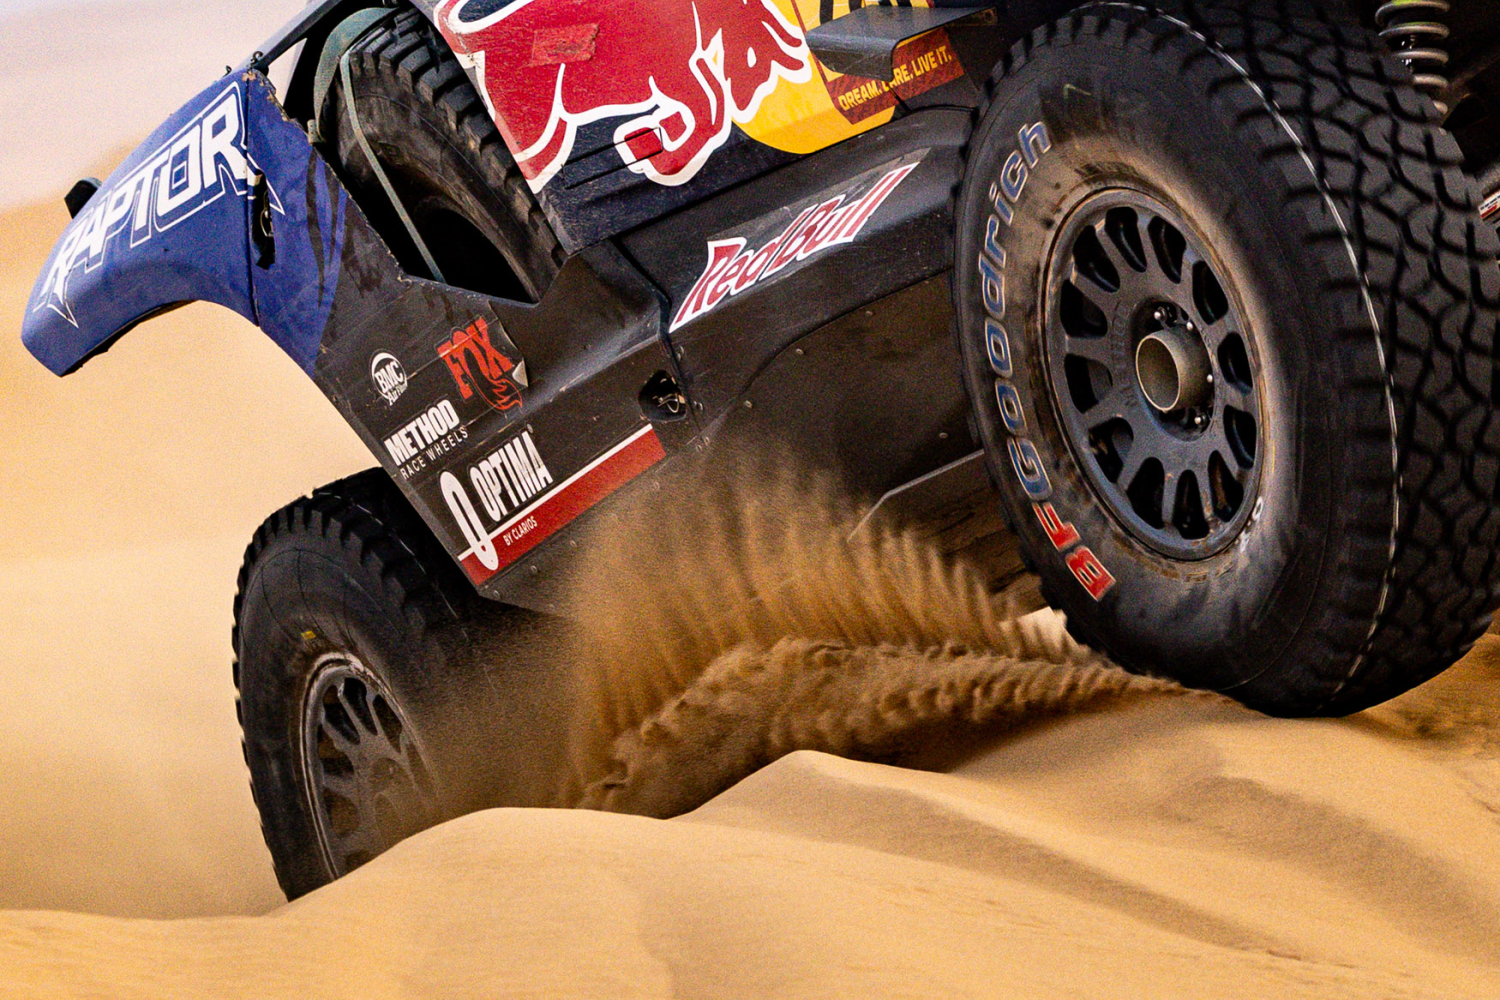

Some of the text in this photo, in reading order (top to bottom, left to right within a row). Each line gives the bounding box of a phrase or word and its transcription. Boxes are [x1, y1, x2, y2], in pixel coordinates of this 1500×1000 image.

[837, 79, 882, 112] DREAM.
[911, 50, 938, 77] LIVE
[32, 80, 285, 328] RAPTOR
[669, 161, 921, 334] Red Bull
[374, 360, 405, 394] BMC
[436, 315, 523, 412] FOX
[383, 399, 460, 467] METHOD
[399, 424, 469, 480] RACE WHEELS
[469, 429, 554, 523] OPTIMA
[502, 515, 538, 547] BY CLARIOS
